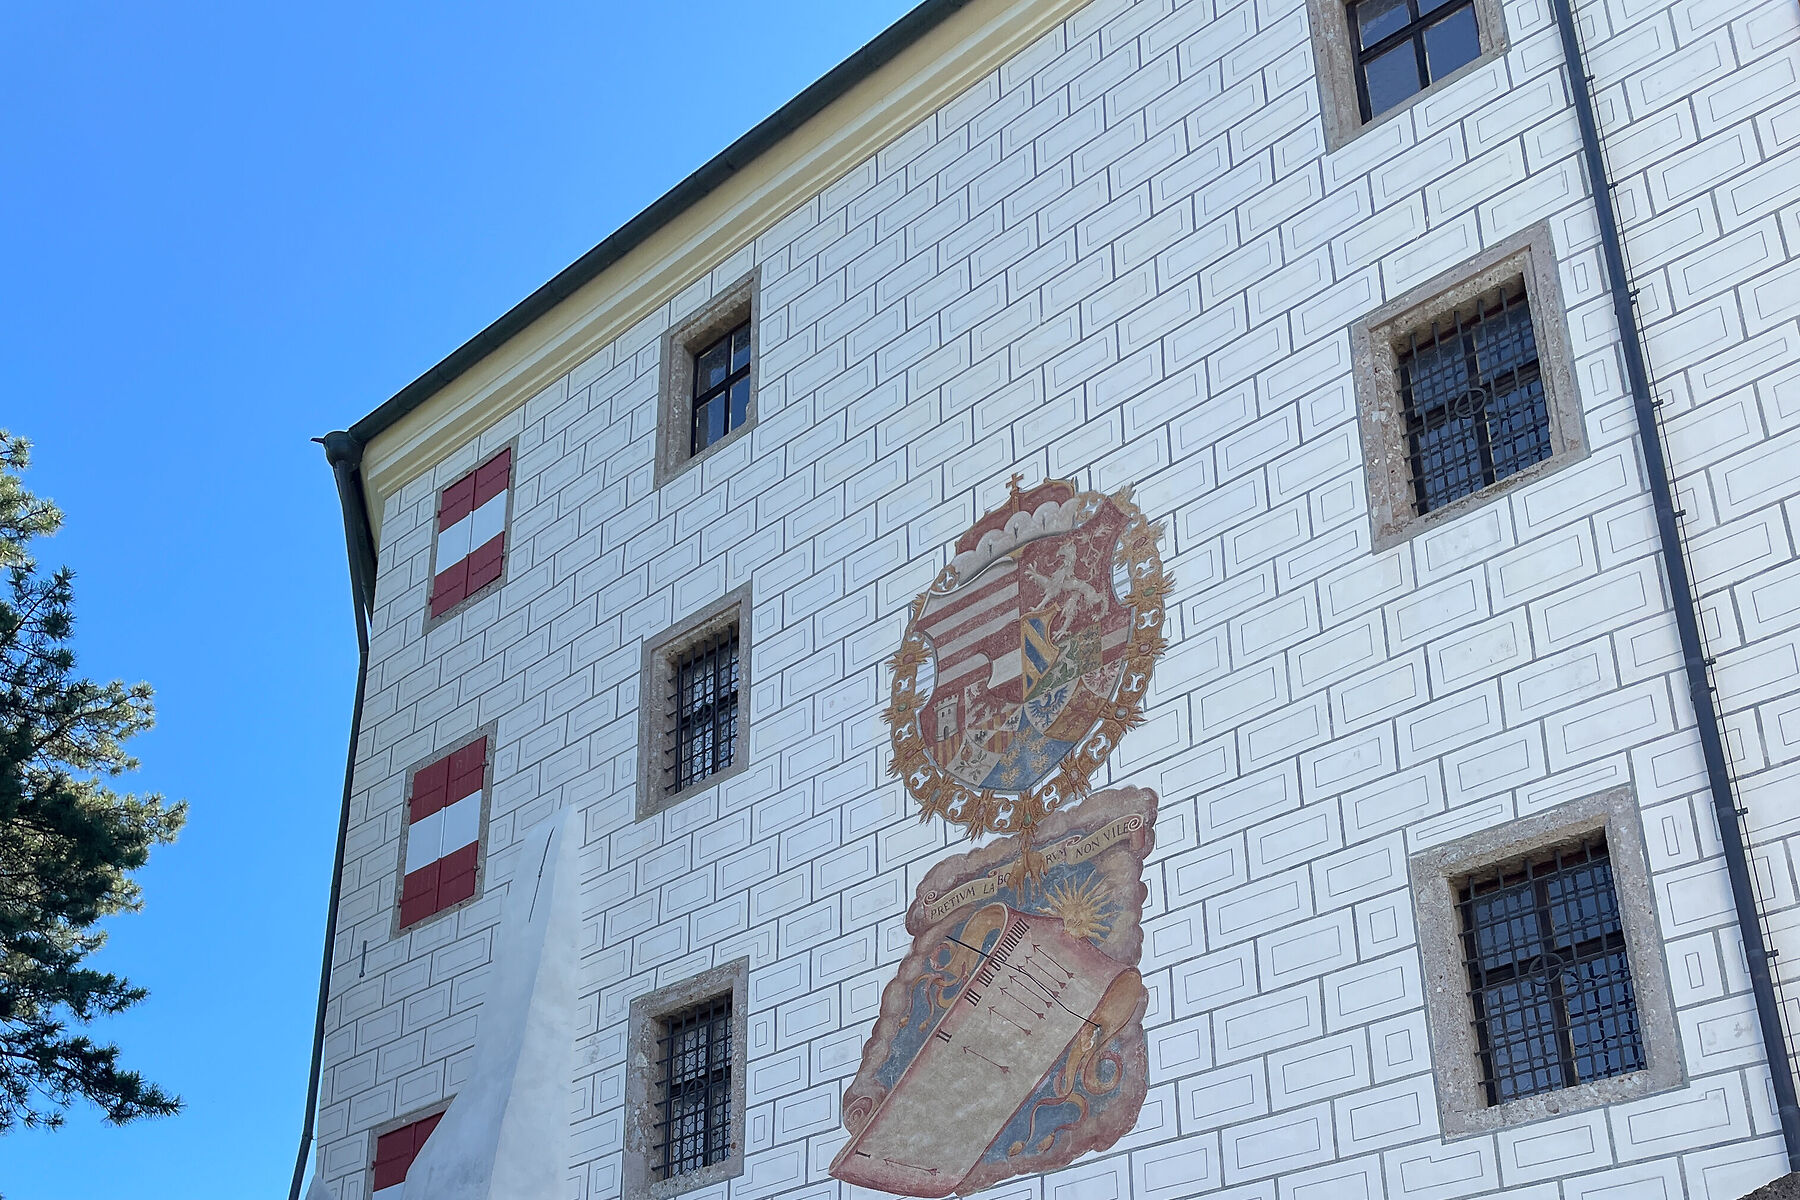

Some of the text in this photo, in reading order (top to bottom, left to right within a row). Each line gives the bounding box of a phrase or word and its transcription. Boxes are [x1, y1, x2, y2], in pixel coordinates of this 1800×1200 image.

[930, 886, 975, 920] PRETIVM
[1075, 837, 1100, 858] NON
[1103, 821, 1129, 841] VILE
[964, 988, 982, 1007] III
[936, 1028, 953, 1044] II
